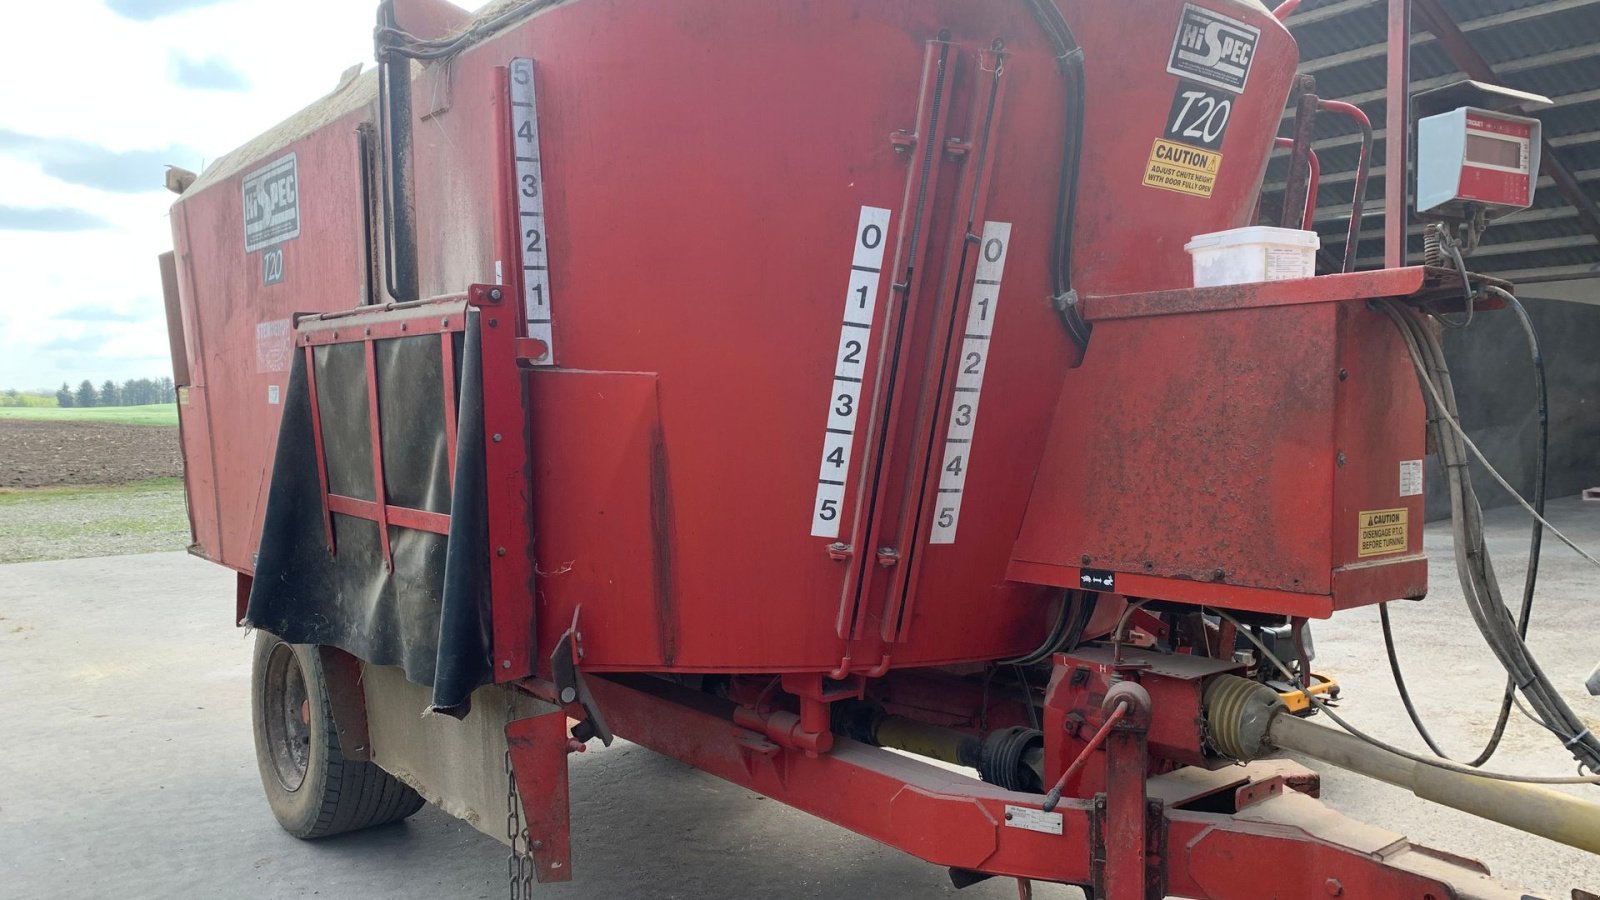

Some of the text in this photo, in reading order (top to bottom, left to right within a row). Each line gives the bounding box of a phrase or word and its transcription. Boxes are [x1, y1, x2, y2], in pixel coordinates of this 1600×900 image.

[514, 62, 530, 85] 5
[1171, 91, 1231, 143] T20
[517, 121, 533, 143] 4
[1156, 144, 1209, 169] CAUTION
[521, 174, 538, 198] 3
[1148, 173, 1212, 193] WITH DOOR FULLY OPEN
[1151, 165, 1214, 185] ADJUST CHUTE HEIGHT
[526, 229, 542, 252] 2
[861, 224, 882, 249] 0
[984, 238, 1003, 263] 0
[264, 249, 283, 283] T20
[531, 283, 543, 306] 1
[856, 286, 868, 309] 1
[977, 298, 989, 320] 1
[844, 340, 862, 364] 2
[963, 352, 982, 374] 2
[835, 394, 853, 417] 3
[955, 404, 972, 427] 3
[826, 446, 845, 468] 4
[946, 456, 962, 476] 4
[819, 500, 837, 521] 5
[937, 507, 954, 528] 5
[1373, 513, 1400, 525] CAUTION
[1362, 528, 1392, 540] DISENGAGE
[1362, 536, 1405, 550] BEFORE TURNING
[1063, 656, 1069, 667] L
[1099, 664, 1107, 673] H
